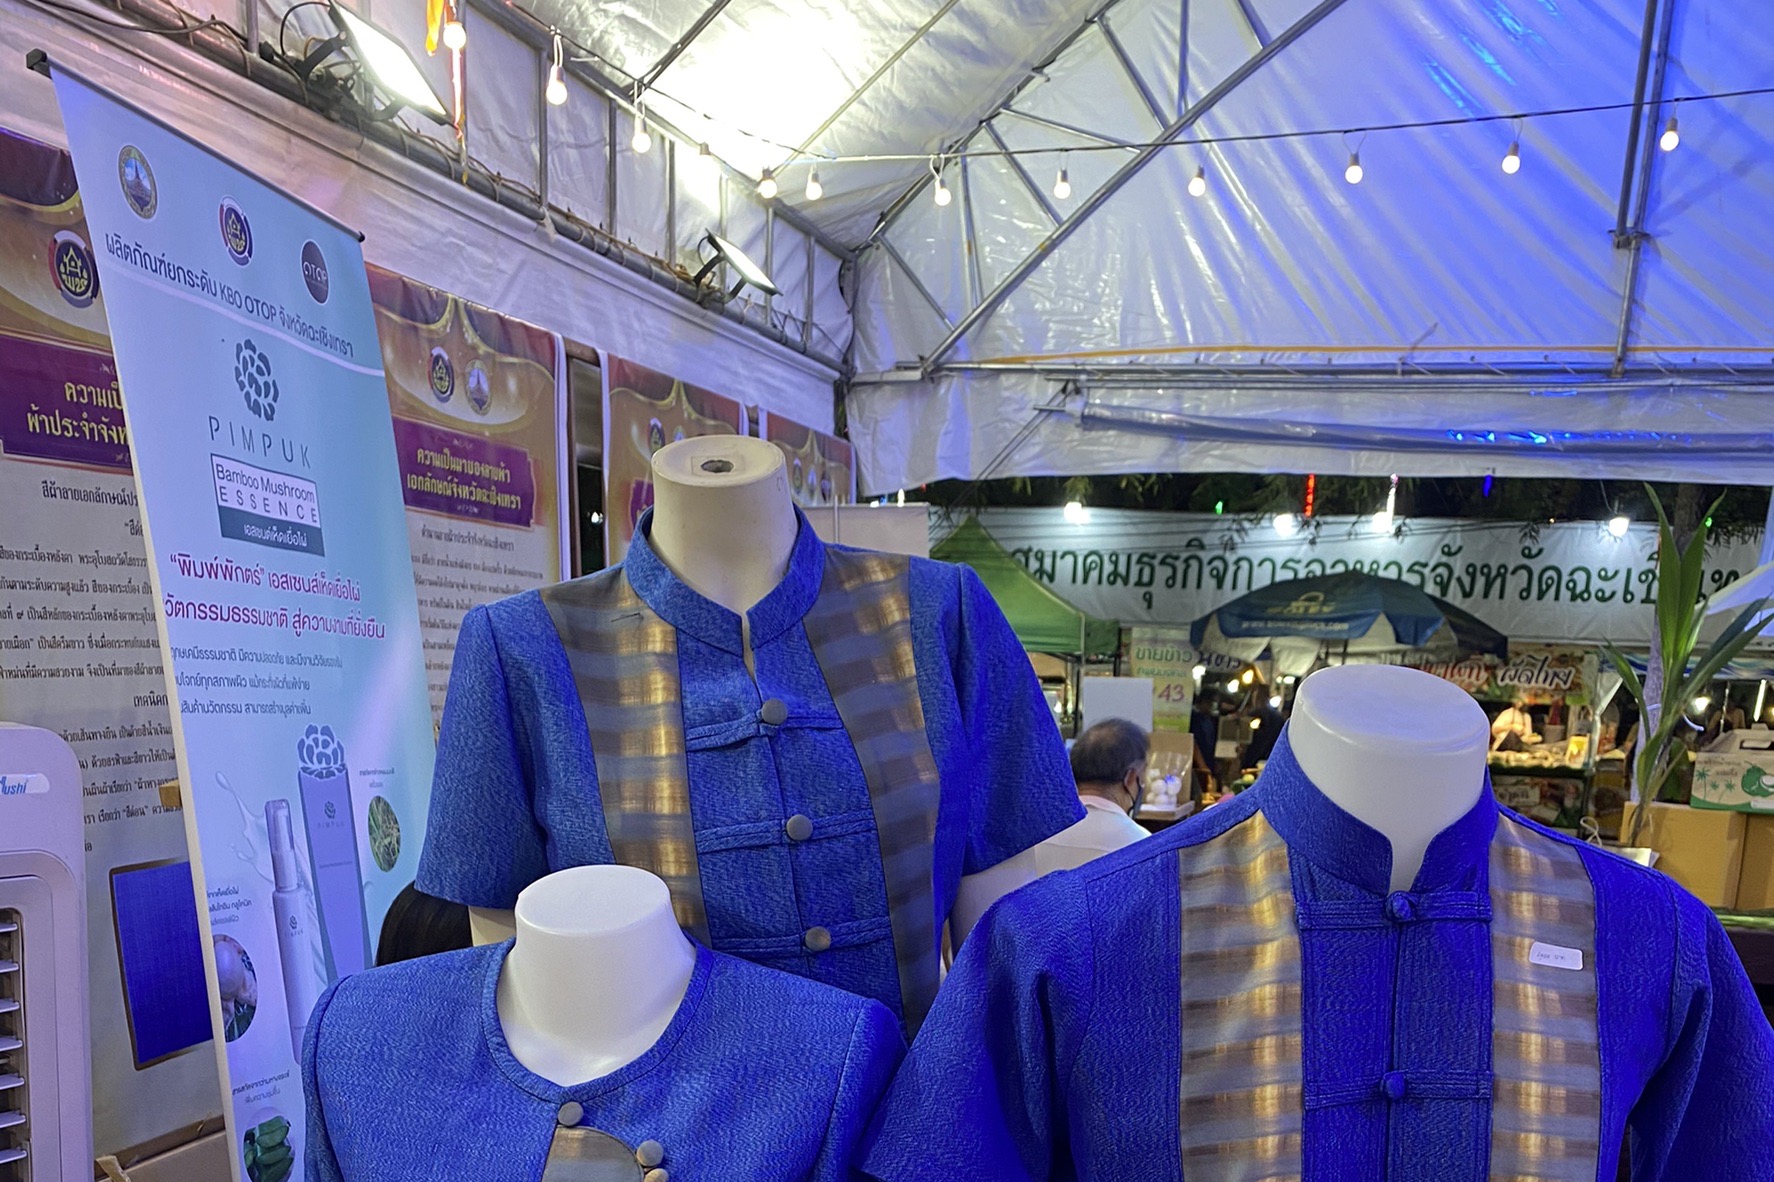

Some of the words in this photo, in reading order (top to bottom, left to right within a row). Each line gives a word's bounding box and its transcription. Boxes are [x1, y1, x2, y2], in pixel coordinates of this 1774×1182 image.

[303, 261, 327, 281] OTOP
[104, 233, 217, 297] ผลิตภัณฑ์ยกระดับ
[219, 282, 243, 309] KBO
[244, 295, 277, 322] OTOP
[279, 305, 354, 358] จังหวัดฉะเชิงเทรา
[208, 415, 311, 469] PIMPUK
[216, 463, 259, 490] Bamboo
[260, 476, 316, 503] Mushroom
[219, 486, 318, 523] ESSENCE
[292, 607, 385, 639] สู่ความงามที่ยั่งยืน
